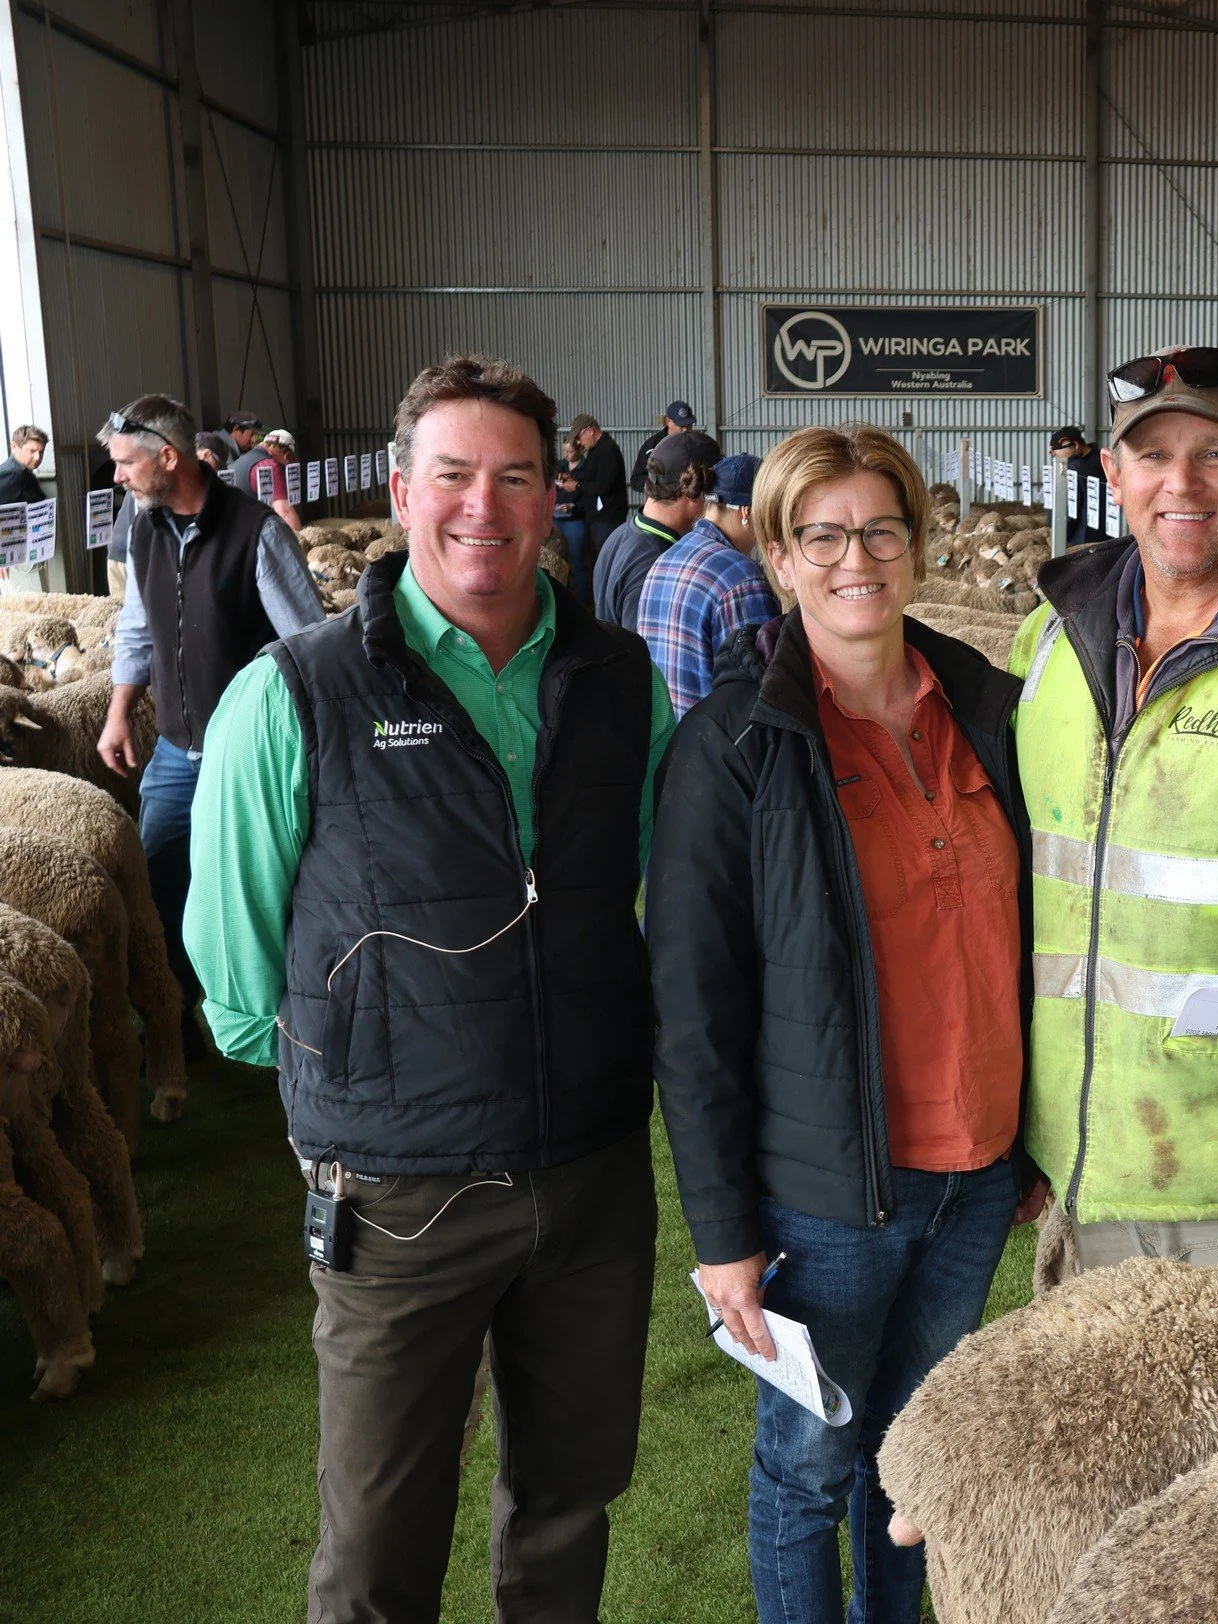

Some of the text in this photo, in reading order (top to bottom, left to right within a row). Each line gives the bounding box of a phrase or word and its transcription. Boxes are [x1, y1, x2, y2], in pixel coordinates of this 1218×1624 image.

[858, 337, 1031, 356] WIRINGA PARK
[912, 371, 951, 382] Nyabing
[891, 380, 973, 389] Western Australia
[373, 719, 443, 737] Nutrien
[373, 737, 429, 750] Ag Solutions
